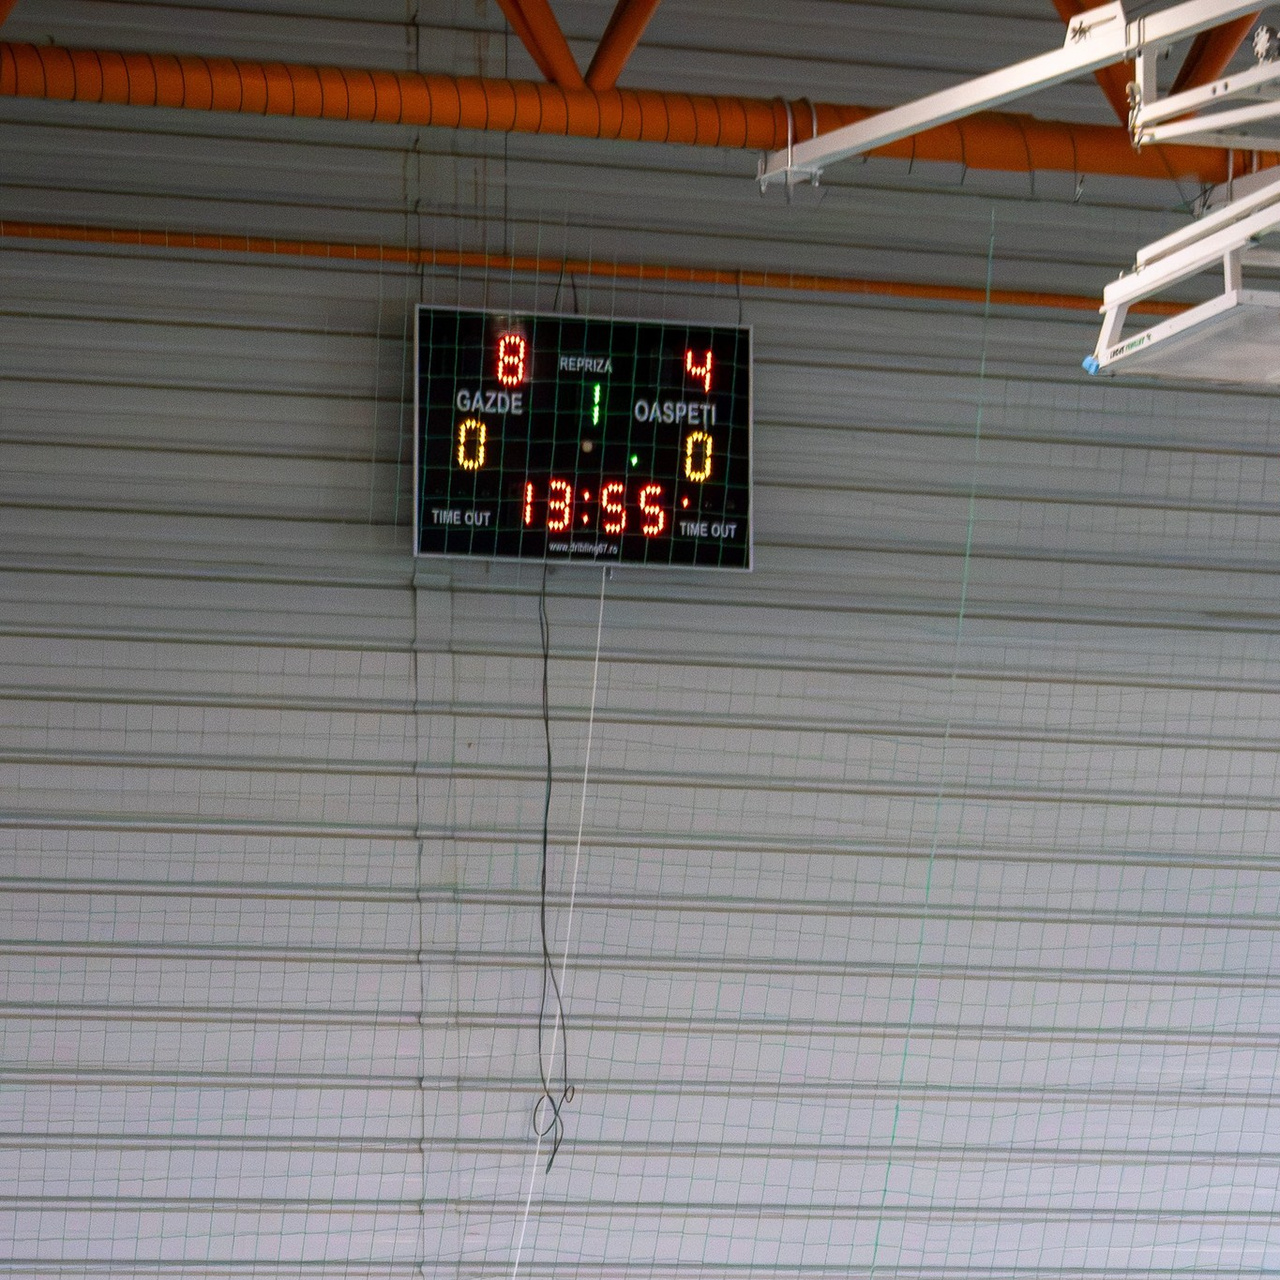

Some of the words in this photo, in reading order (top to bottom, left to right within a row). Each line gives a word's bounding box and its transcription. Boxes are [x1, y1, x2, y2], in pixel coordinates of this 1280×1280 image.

[498, 334, 526, 386] 8
[685, 350, 713, 393] 4
[457, 390, 523, 415] GAZDE
[592, 382, 601, 426] 1
[457, 418, 487, 471] 0
[684, 431, 713, 482] 0
[431, 509, 461, 525] TIME
[464, 511, 491, 527] OUT
[680, 521, 708, 537] TIME
[711, 523, 737, 539] OUT
